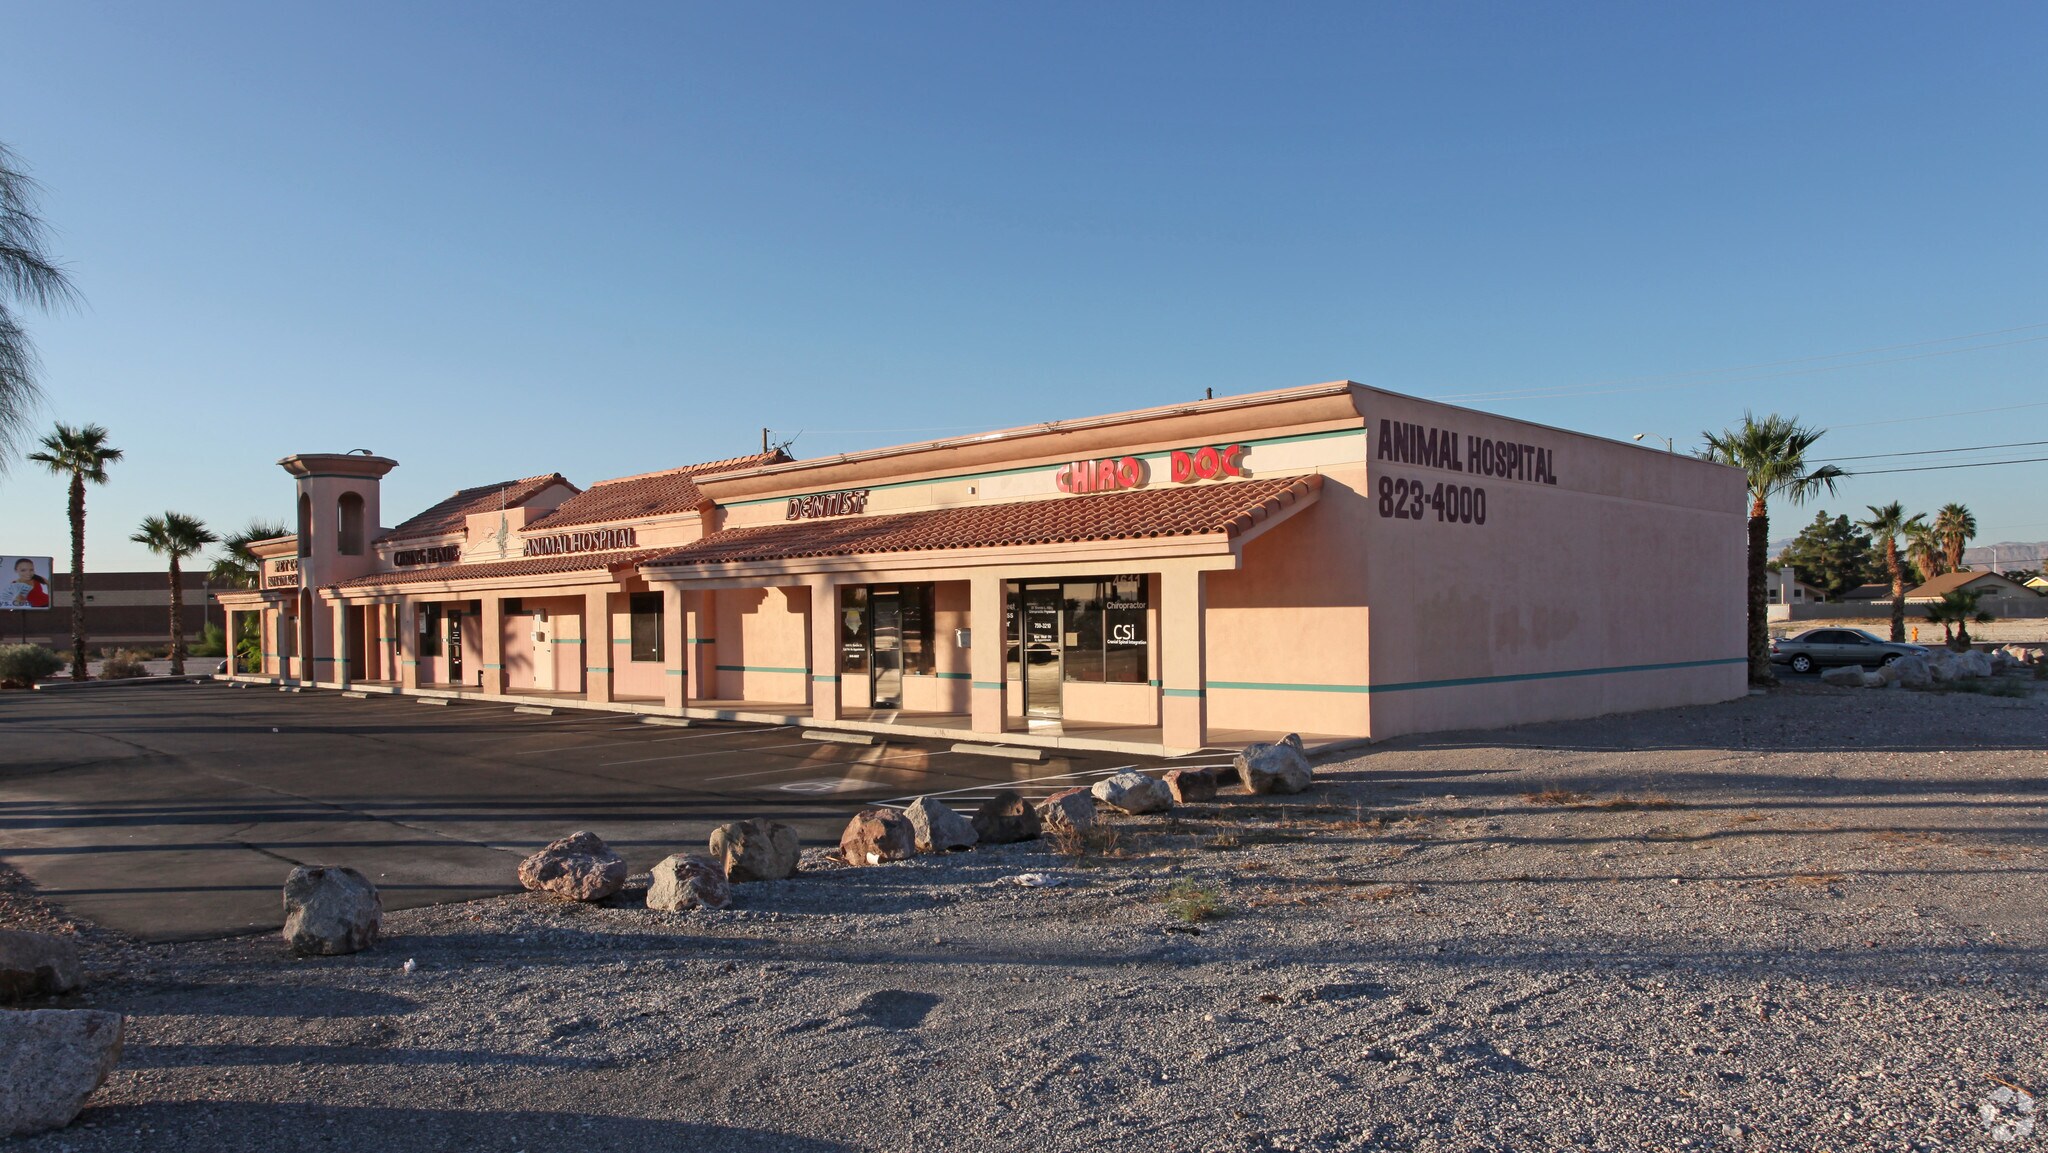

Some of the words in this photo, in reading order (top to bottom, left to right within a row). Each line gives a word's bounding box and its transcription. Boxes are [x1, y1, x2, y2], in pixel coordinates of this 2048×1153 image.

[1377, 419, 1462, 472] ANIMAL
[1467, 435, 1557, 485] HOSPITAL
[1056, 456, 1142, 493] CHIRO
[1170, 444, 1243, 483] DOC
[786, 489, 867, 520] DENTIST
[1378, 475, 1486, 525] 823-4000
[524, 534, 569, 556] ANIMAL
[570, 528, 637, 552] HOSPITAL
[1113, 574, 1140, 587] 4611
[1107, 602, 1146, 611] Chiropractor
[1113, 624, 1135, 640] CSi
